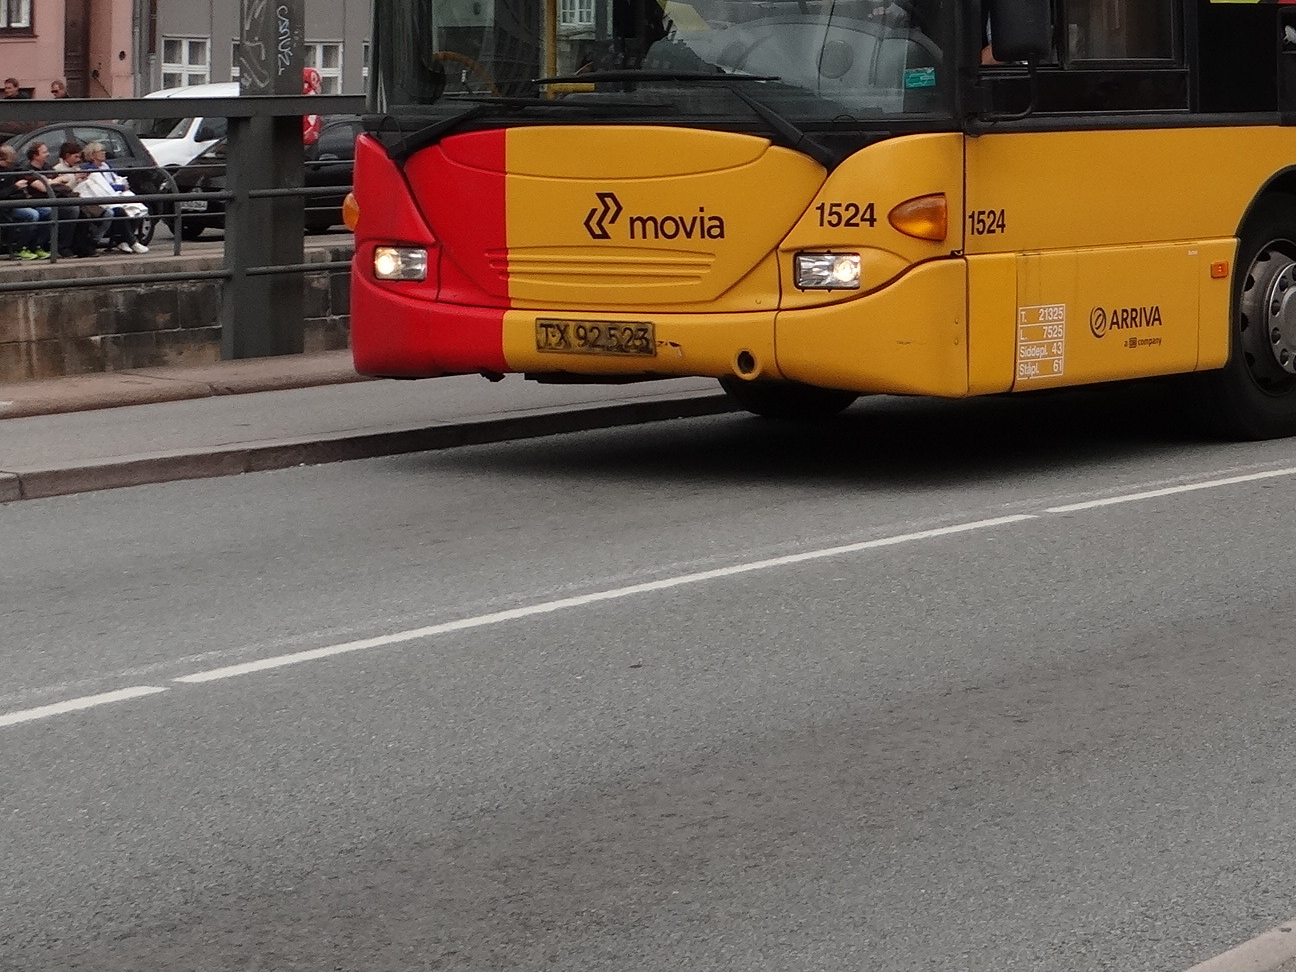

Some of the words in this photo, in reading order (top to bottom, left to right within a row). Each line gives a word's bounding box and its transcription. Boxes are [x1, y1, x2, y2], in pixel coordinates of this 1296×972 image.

[629, 206, 726, 240] movia
[815, 202, 877, 228] 1524
[968, 209, 1006, 236] 1524
[1038, 308, 1064, 321] 21325
[1109, 305, 1163, 330] ARRIVA
[574, 324, 602, 348] 92
[606, 326, 652, 351] 523
[1043, 326, 1063, 339] 7525
[1051, 342, 1063, 355] 43
[1053, 360, 1063, 372] 61
